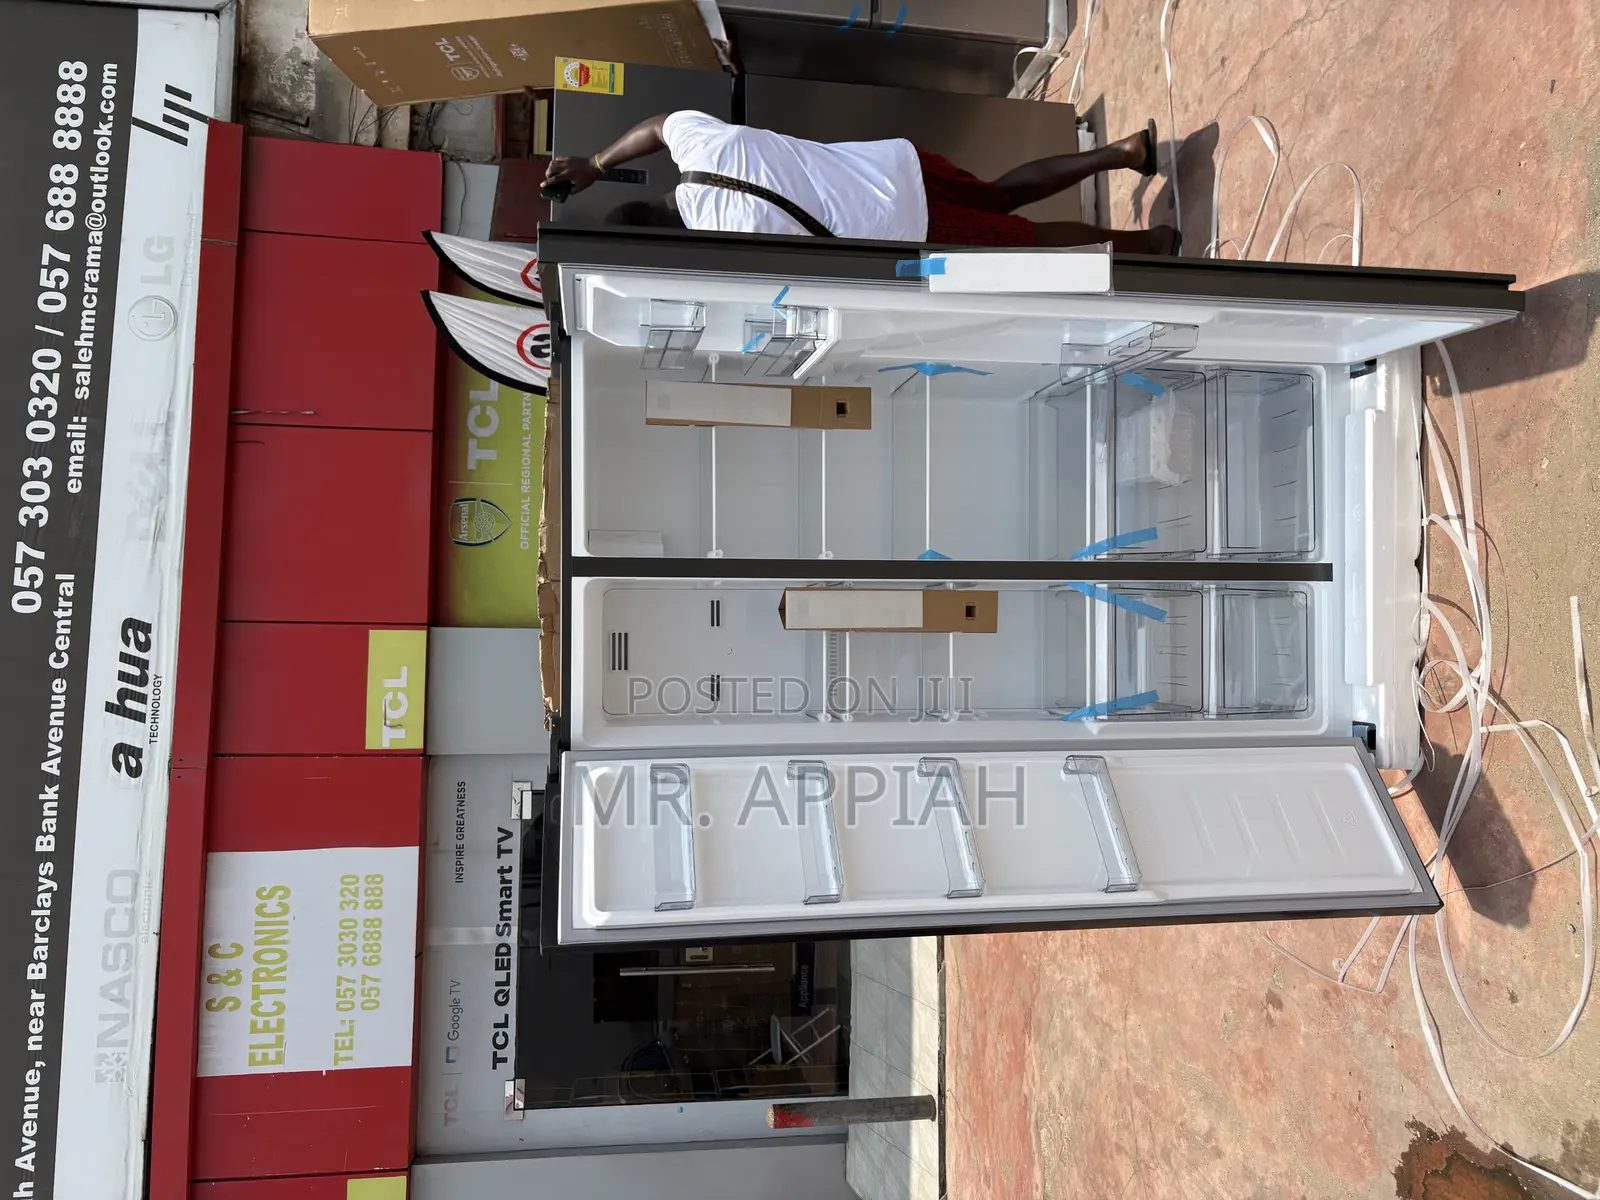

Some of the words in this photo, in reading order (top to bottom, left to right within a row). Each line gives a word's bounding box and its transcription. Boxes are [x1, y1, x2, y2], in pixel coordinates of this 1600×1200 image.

[434, 37, 460, 60] TCL
[52, 59, 88, 151] 8888
[44, 162, 80, 231] 688
[75, 62, 119, 399] salehmcrama@outlook.com
[140, 235, 175, 285] LG
[37, 243, 71, 313] 057
[34, 324, 65, 336] /
[25, 347, 63, 442] 0320
[467, 377, 498, 469] TCL
[66, 414, 88, 493] email:
[521, 433, 531, 492] REGIONAL
[17, 455, 53, 527] 303
[458, 502, 469, 539] Arsenal
[520, 495, 530, 549] OFFICIAL
[9, 540, 46, 613] 057
[49, 573, 76, 669] Central
[41, 677, 68, 775] Avenue
[148, 673, 163, 744] TECHNOLOGY
[380, 665, 408, 748] TCL
[35, 783, 60, 852] Bank
[455, 780, 466, 840] GREATNESS
[454, 842, 465, 883] INSPIRE
[497, 825, 514, 858] TV
[27, 861, 58, 979] Barclays
[340, 873, 360, 910] 320
[364, 872, 384, 910] 888
[495, 864, 514, 936] Smart
[96, 868, 139, 1047] NASCO
[207, 941, 244, 959] C
[338, 916, 358, 966] 3030
[362, 916, 383, 966] 6888
[205, 995, 242, 1011] S
[206, 967, 243, 986] &
[248, 883, 291, 1066] ELECTRONICS
[336, 974, 357, 1011] 057
[360, 973, 382, 1010] 057
[450, 978, 461, 995] TV
[494, 941, 512, 1006] QLED
[798, 963, 809, 1007] Appliance
[27, 987, 46, 1049] near
[333, 1018, 355, 1065] TEL:
[447, 997, 463, 1040] Google
[492, 1012, 509, 1069] TCL
[14, 1059, 46, 1171] Avenue,
[443, 1084, 458, 1126] TCL
